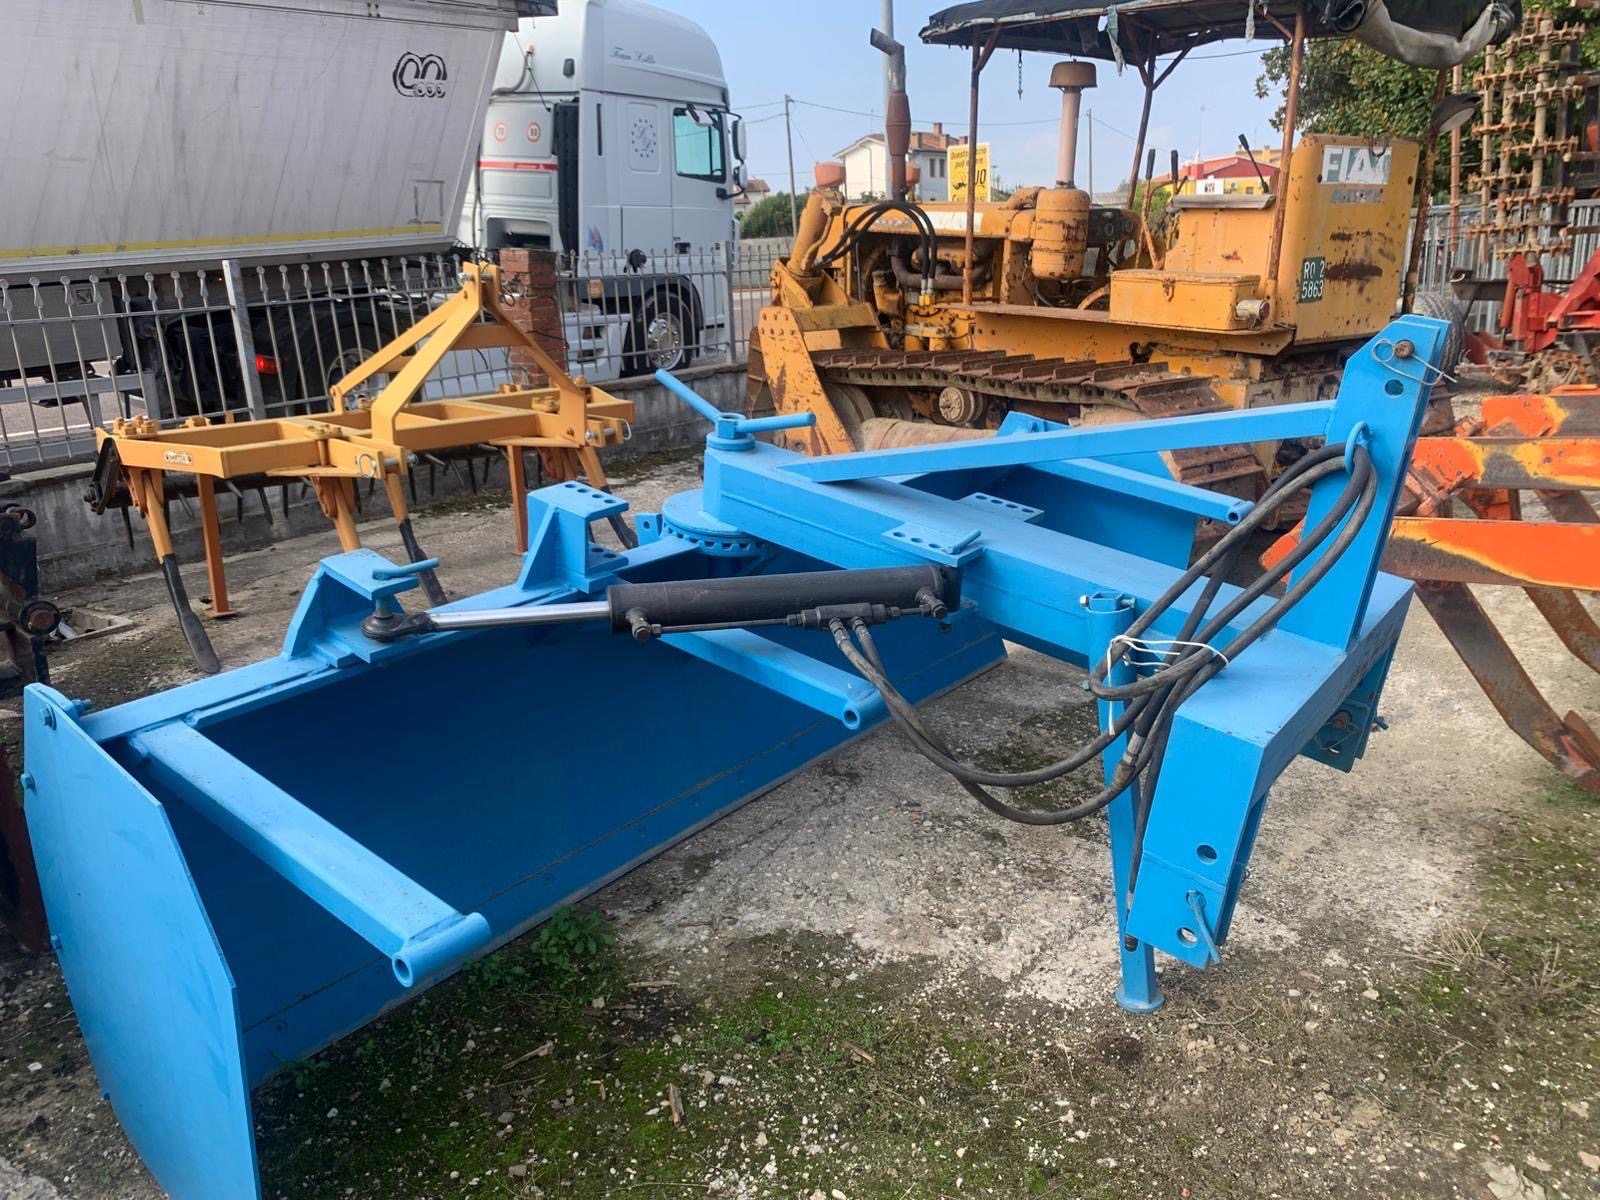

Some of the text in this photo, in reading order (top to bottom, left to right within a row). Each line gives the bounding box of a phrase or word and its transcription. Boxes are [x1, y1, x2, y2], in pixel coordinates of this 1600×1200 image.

[1303, 260, 1325, 280] RO 2
[1301, 279, 1324, 299] 5863
